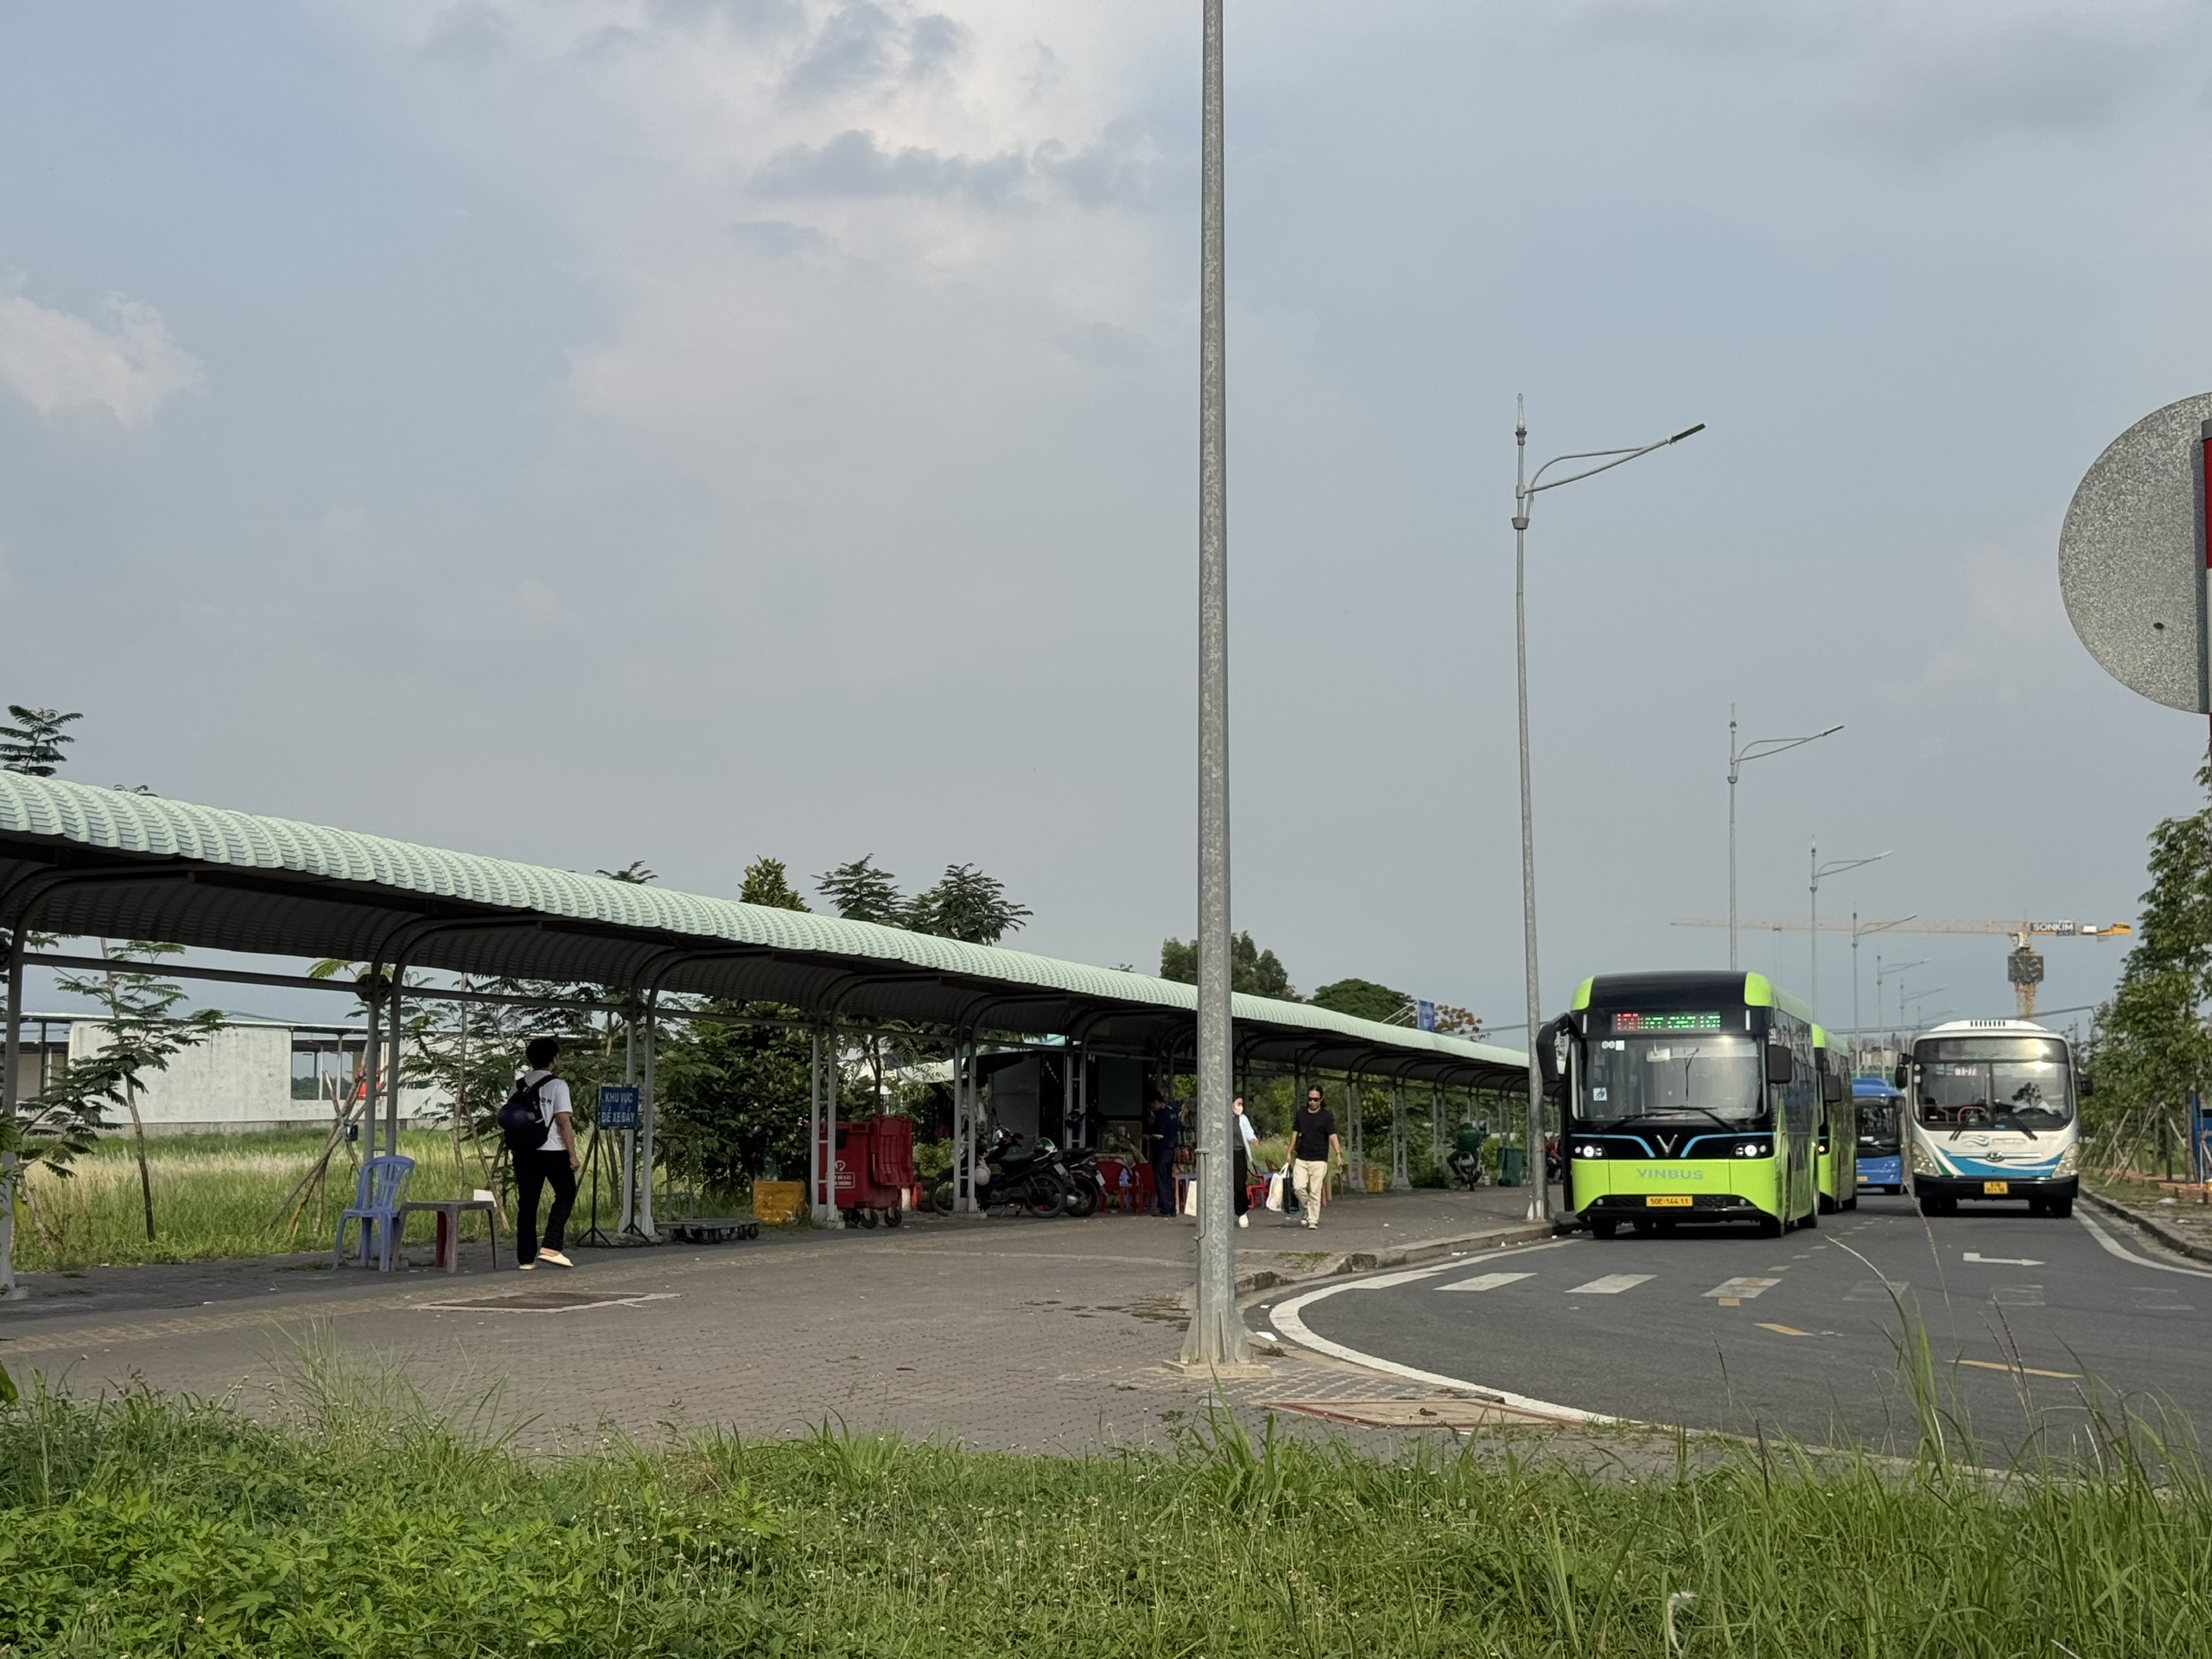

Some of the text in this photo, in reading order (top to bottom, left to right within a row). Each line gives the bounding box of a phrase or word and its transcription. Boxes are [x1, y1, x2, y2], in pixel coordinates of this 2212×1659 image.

[605, 1091, 620, 1103] KHU
[613, 1111, 621, 1123] XE
[1637, 1168, 1704, 1179] VINBUS
